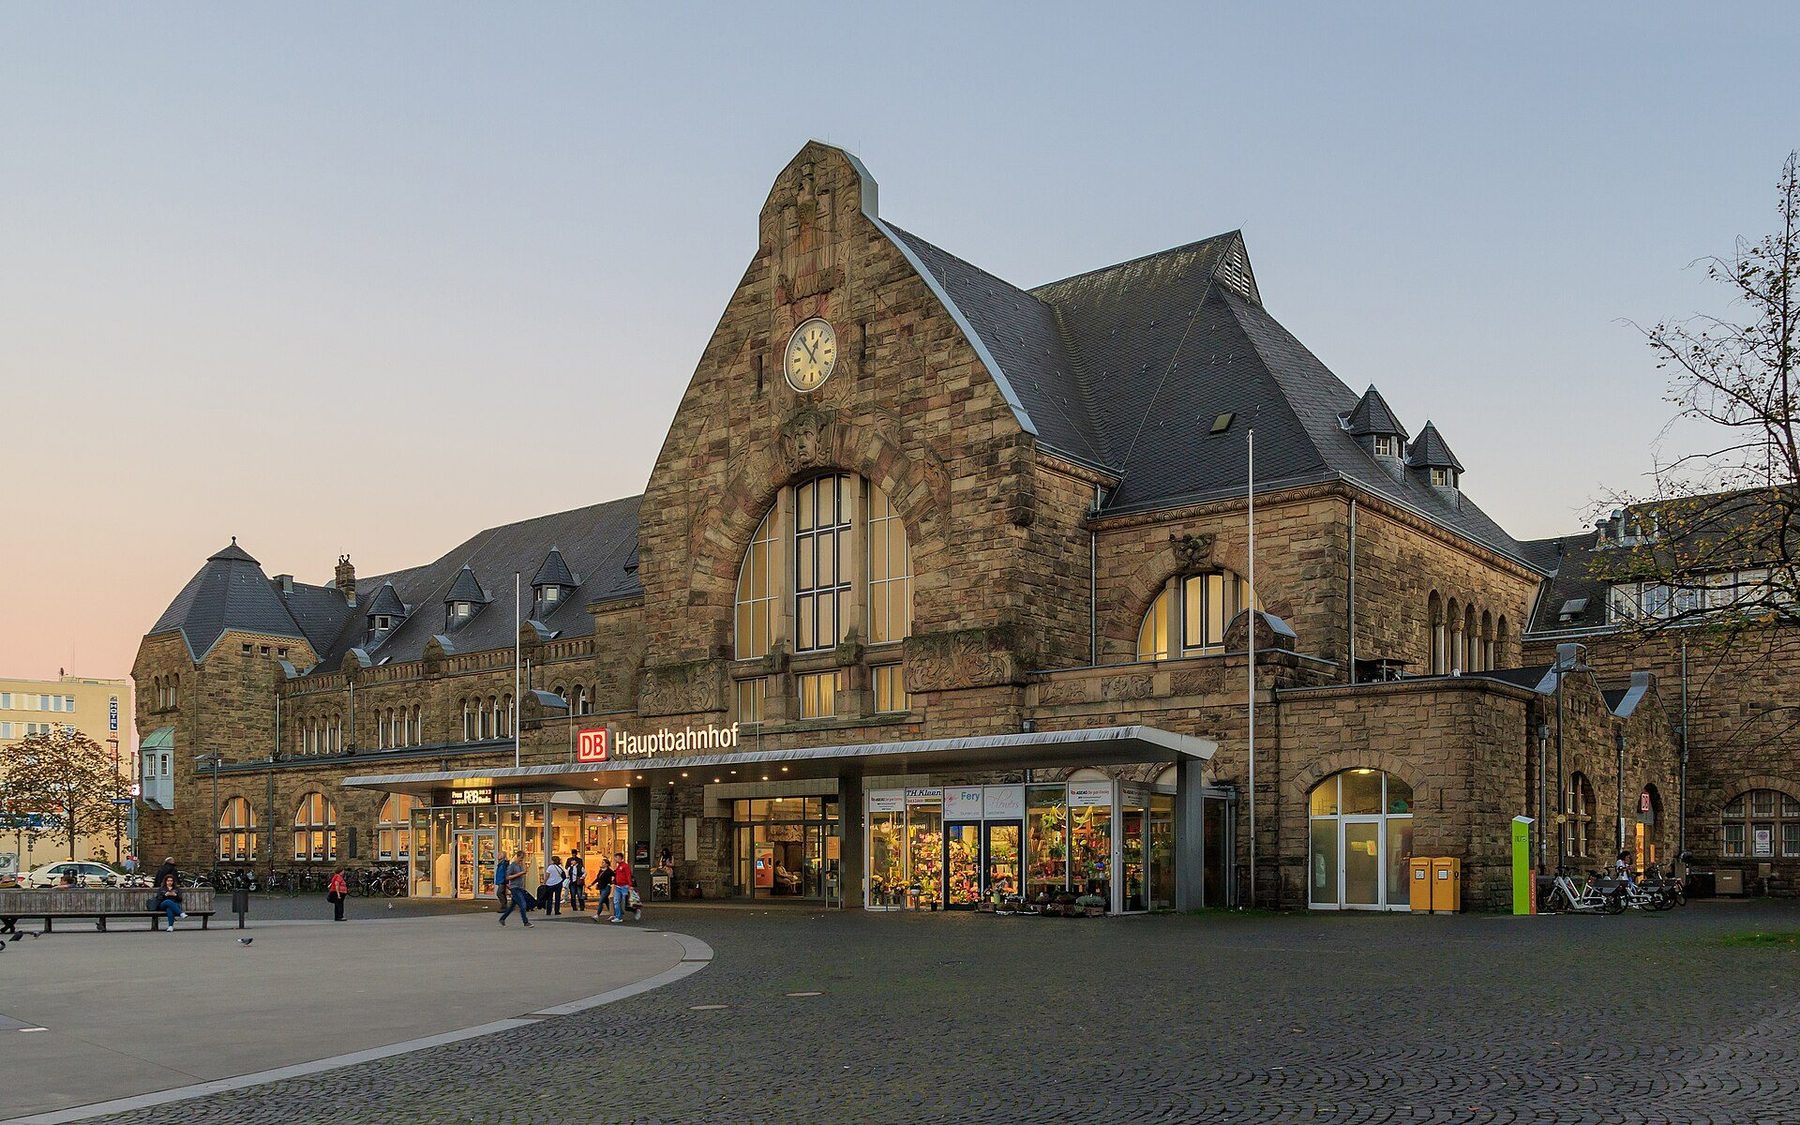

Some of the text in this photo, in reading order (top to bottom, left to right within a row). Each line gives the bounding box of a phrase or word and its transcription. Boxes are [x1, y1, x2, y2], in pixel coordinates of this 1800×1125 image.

[582, 734, 604, 757] DB
[615, 722, 739, 758] Hauptbahnhof
[961, 791, 980, 802] Fery
